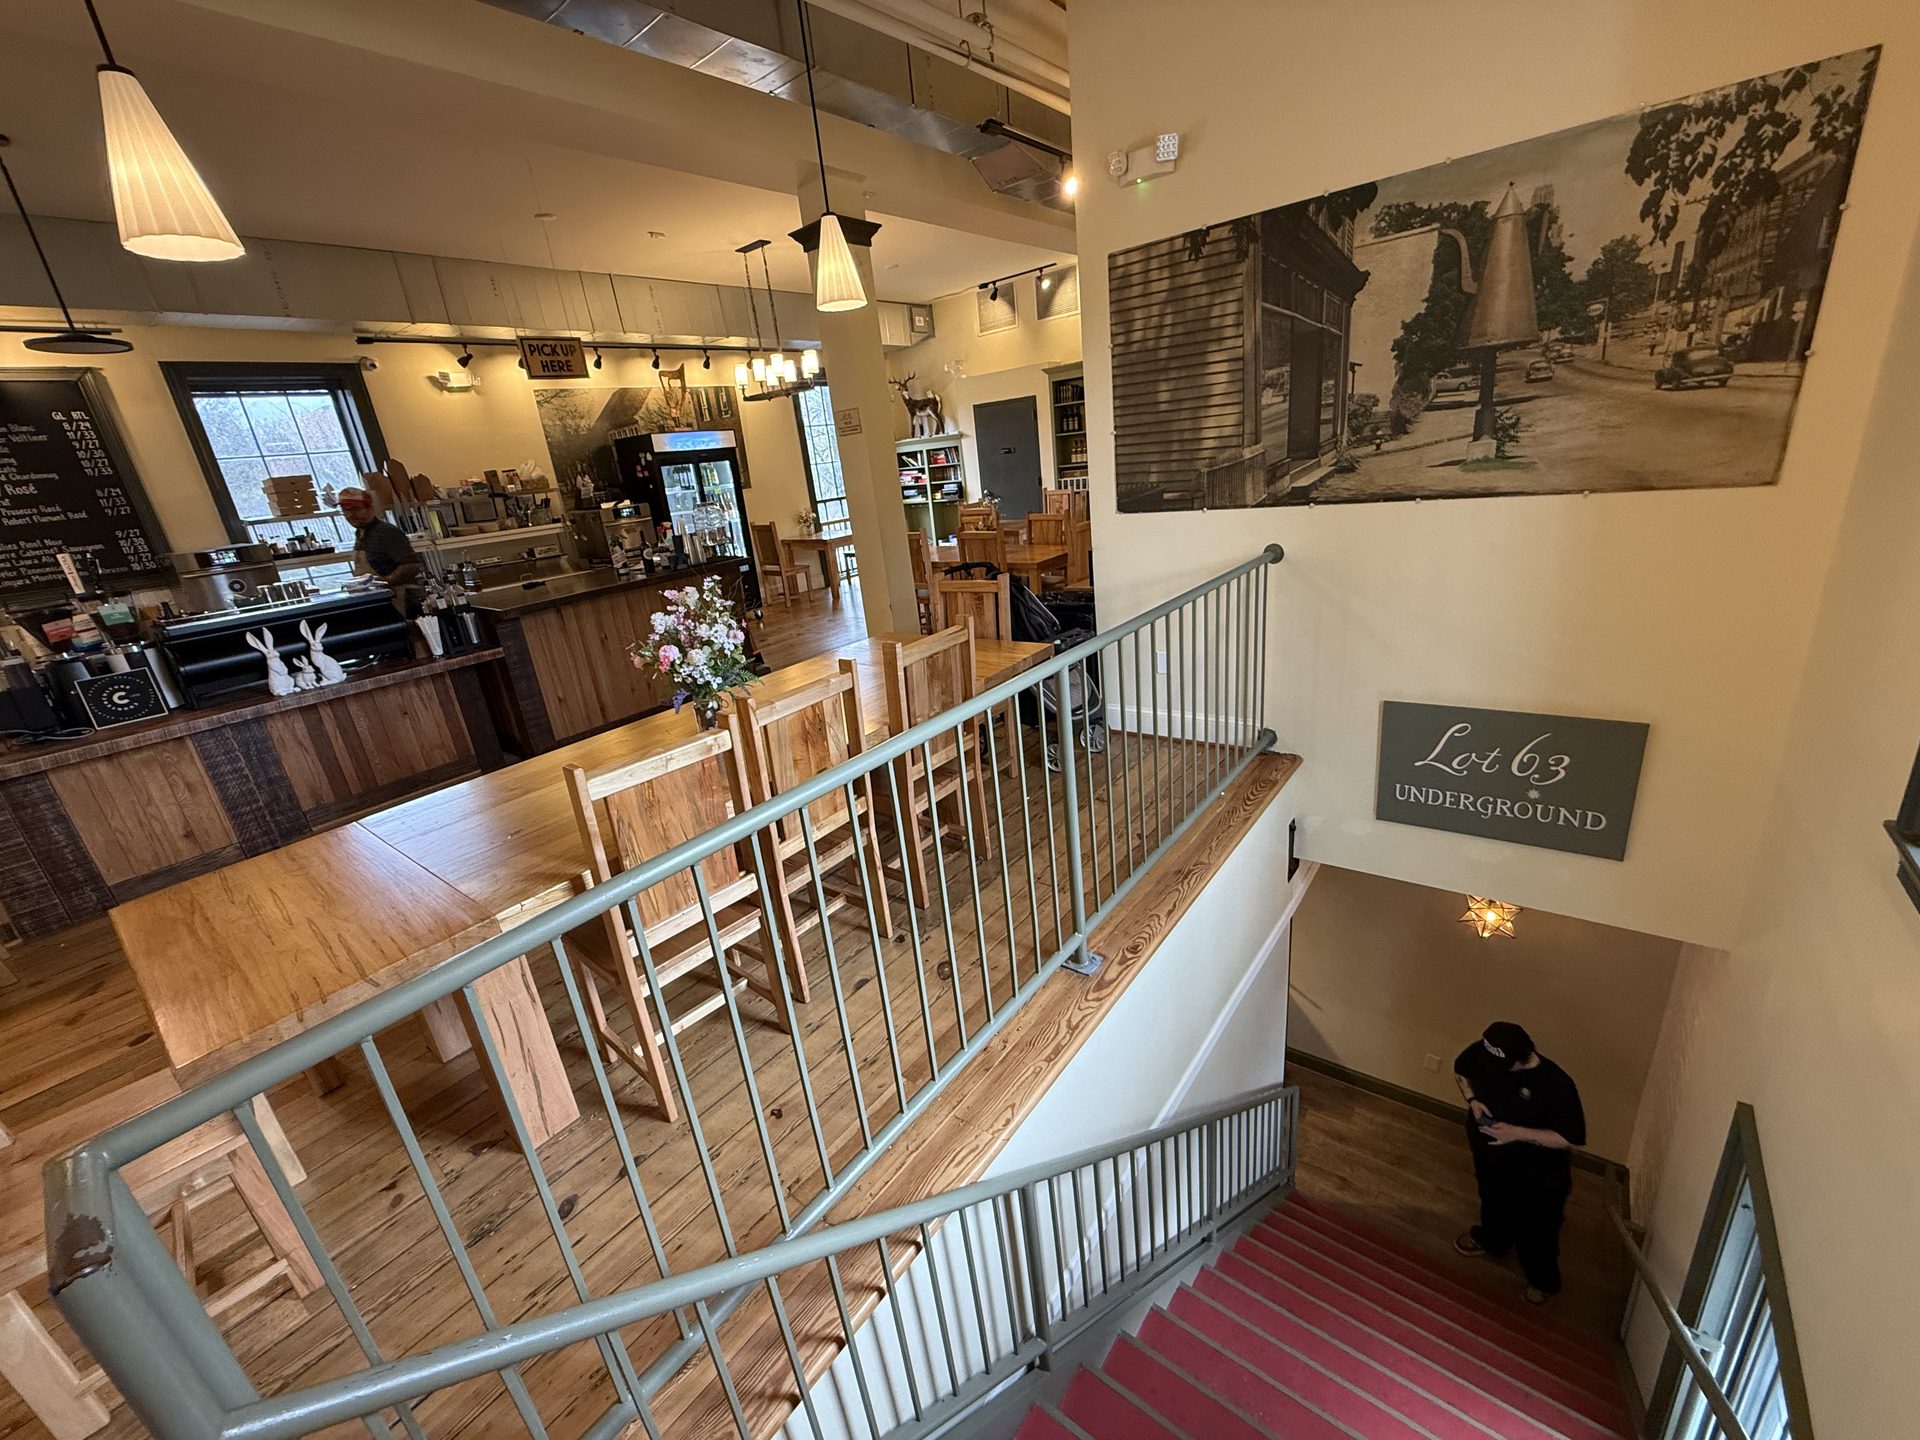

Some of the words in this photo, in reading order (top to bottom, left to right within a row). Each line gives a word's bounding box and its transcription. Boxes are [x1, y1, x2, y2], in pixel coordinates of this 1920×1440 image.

[528, 343, 560, 357] PICK
[560, 343, 577, 357] UP
[540, 359, 574, 373] HERE
[51, 411, 67, 420] GL
[71, 411, 90, 420] BTL
[1413, 722, 1502, 777] Lot
[1511, 733, 1570, 785] 63
[1394, 783, 1607, 832] UNDERGROUND
